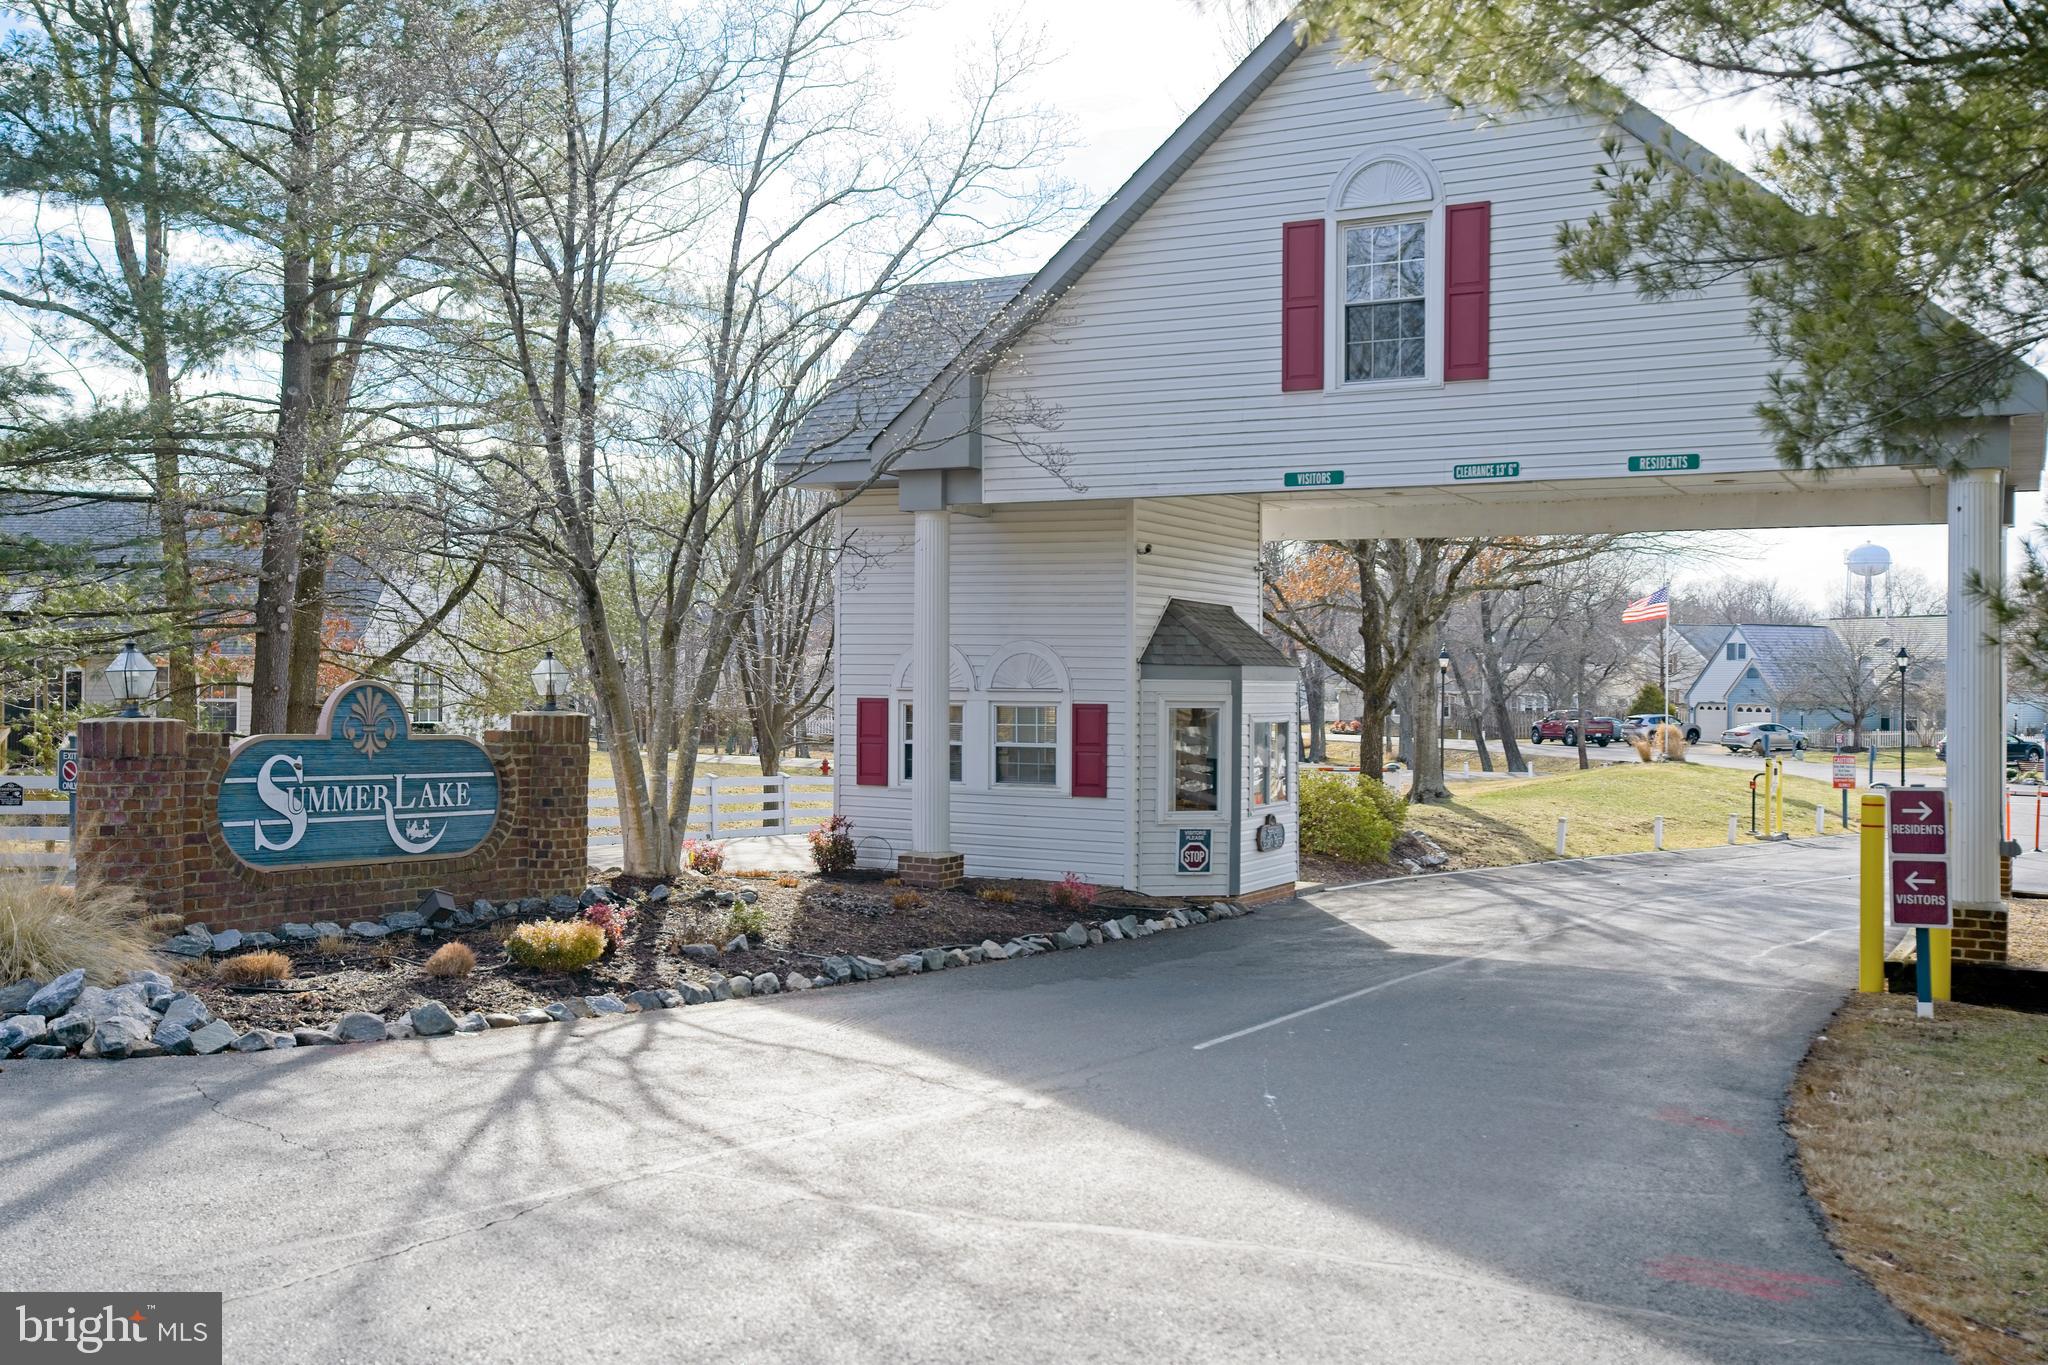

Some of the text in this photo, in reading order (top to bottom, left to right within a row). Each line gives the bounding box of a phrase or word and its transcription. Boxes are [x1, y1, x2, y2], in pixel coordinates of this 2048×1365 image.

[1639, 455, 1688, 470] RESIDENTS
[1455, 464, 1494, 478] CLEARANCE
[1297, 472, 1331, 485] VISITORS
[63, 752, 77, 760] EXIT
[62, 781, 77, 790] ONLY
[1892, 824, 1944, 835] RESIDENTS
[1184, 851, 1205, 863] STOP
[1896, 894, 1946, 906] VISITORS
